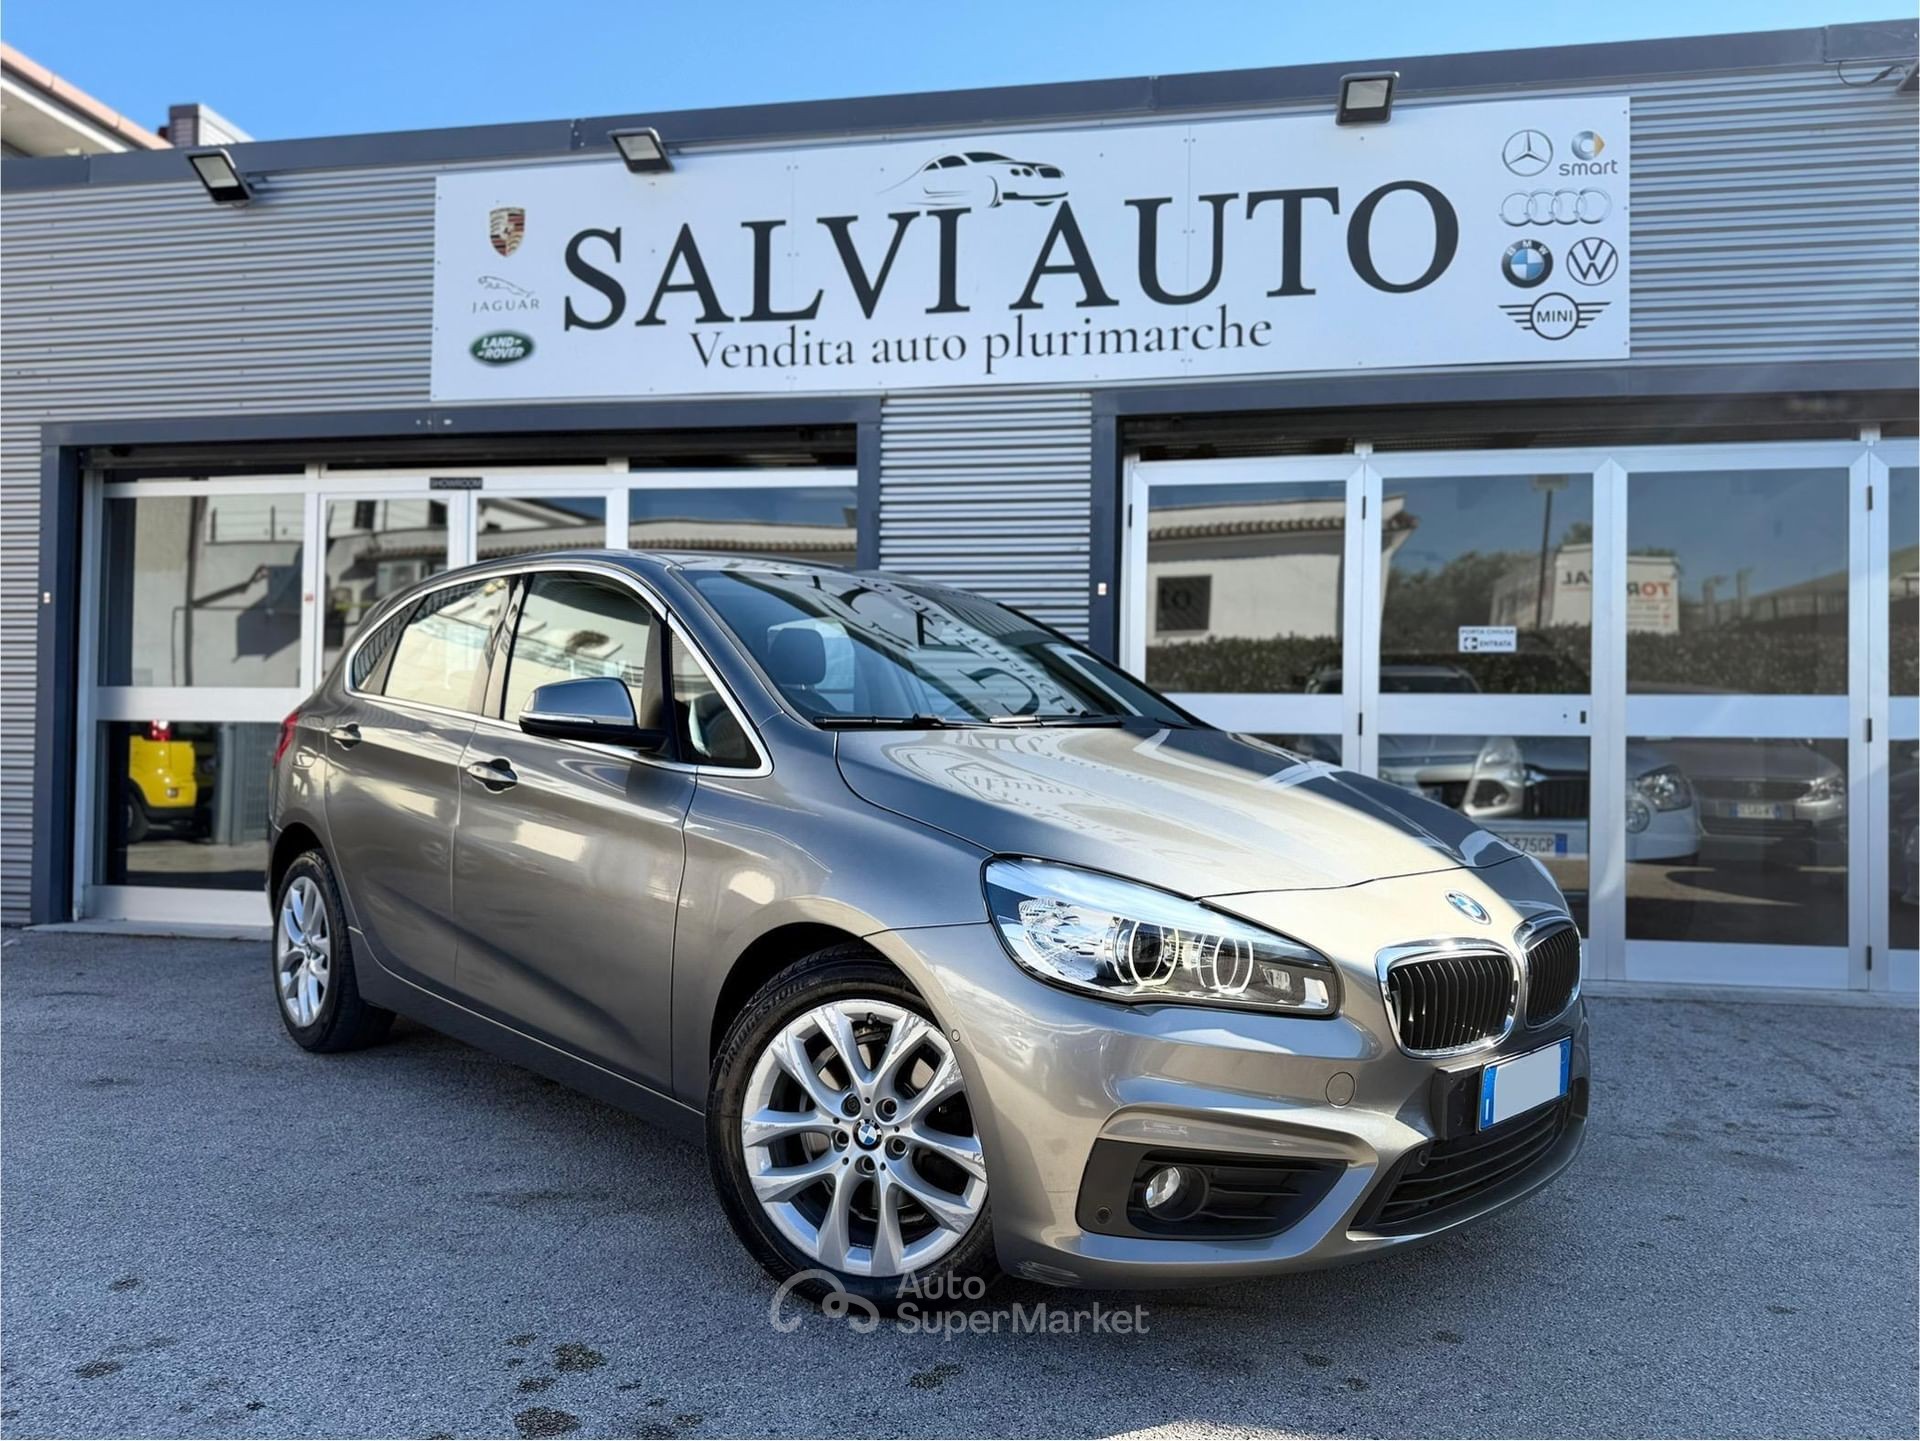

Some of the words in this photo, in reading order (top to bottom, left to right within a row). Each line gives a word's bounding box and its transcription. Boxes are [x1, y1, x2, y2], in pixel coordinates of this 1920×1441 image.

[1558, 159, 1619, 176] smart
[563, 206, 972, 332] SALVI
[1008, 180, 1460, 311] AUTO
[472, 298, 540, 314] JAGUAR
[1536, 309, 1573, 323] MINI
[481, 336, 515, 349] LAND
[690, 324, 856, 370] Vendita
[871, 331, 967, 365] auto
[984, 303, 1273, 374] plurimarche
[484, 346, 525, 360] ROVER
